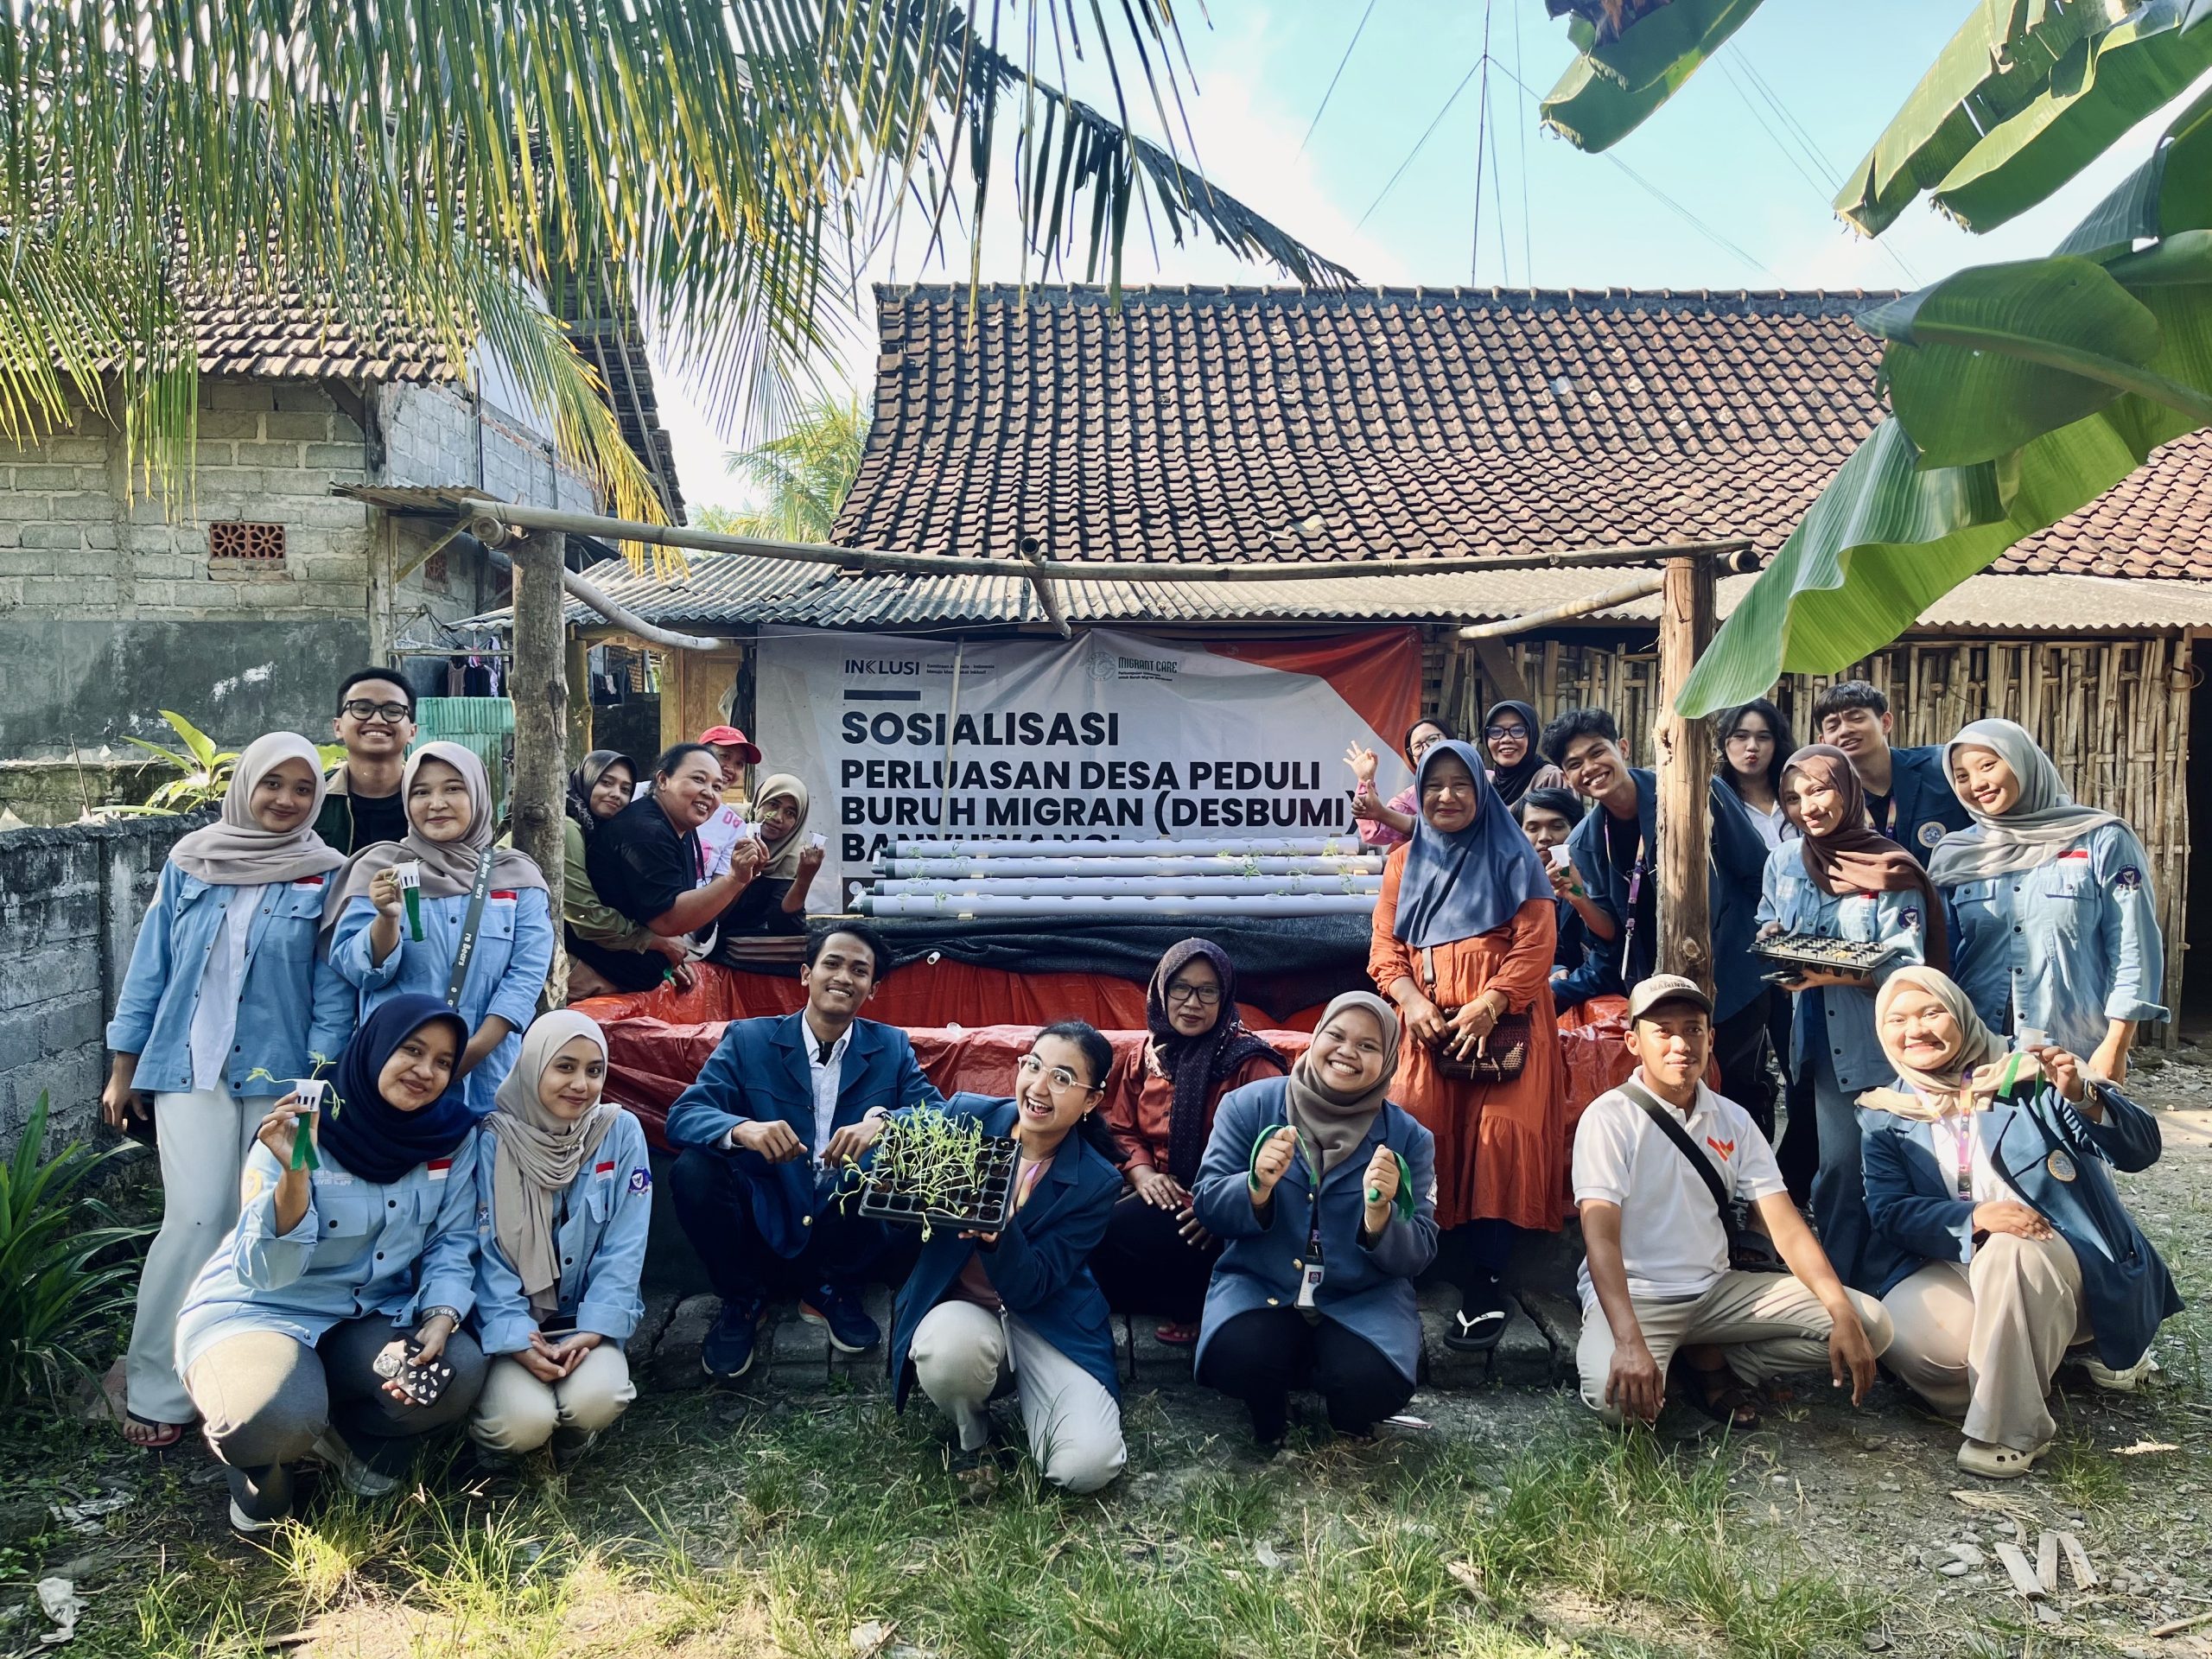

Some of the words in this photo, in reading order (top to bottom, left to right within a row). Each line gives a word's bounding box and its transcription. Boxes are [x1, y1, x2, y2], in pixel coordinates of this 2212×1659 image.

[844, 659, 920, 676] INKLUSI
[1118, 657, 1154, 671] MIGRANT
[1155, 661, 1178, 673] CARE
[842, 710, 1118, 746] SOSIALISASI
[841, 760, 1071, 790] PERLUASAN
[1080, 761, 1180, 790] DESA
[1189, 761, 1320, 790] PEDULI
[841, 797, 976, 826] BURUH
[986, 798, 1143, 827] MIGRAN
[1154, 790, 1357, 836] (DESBUMI)
[458, 943, 472, 966] Bears
